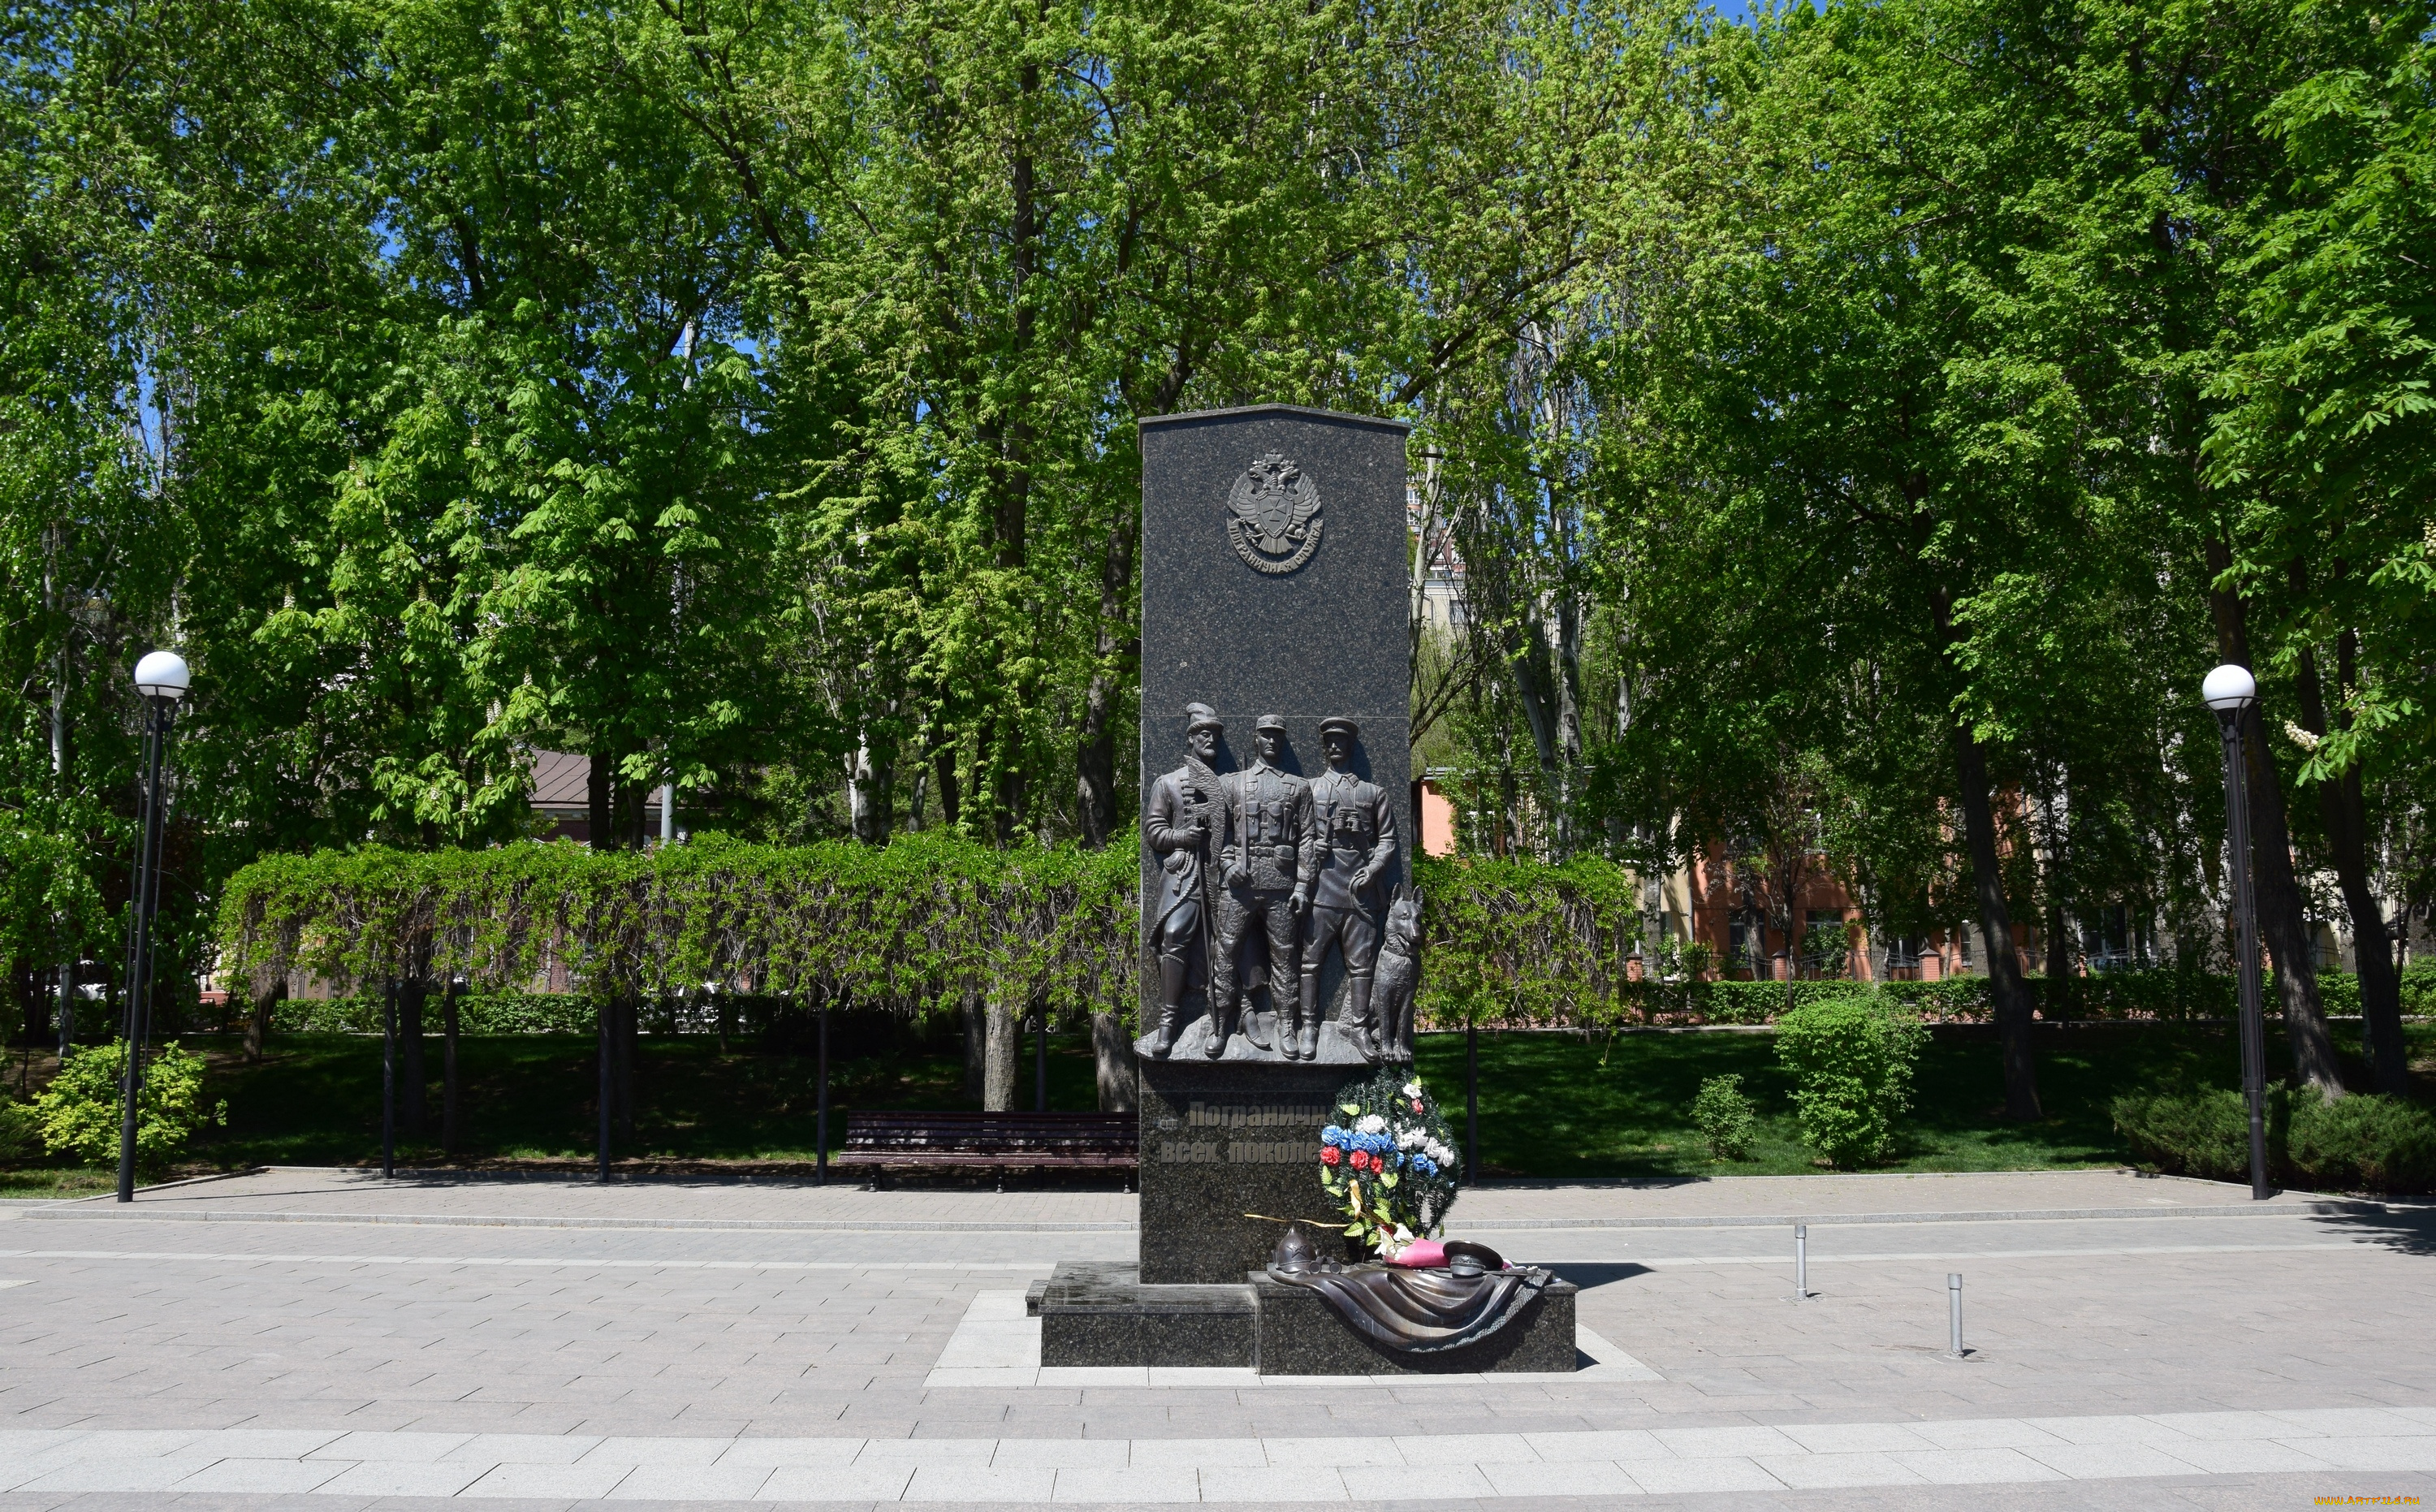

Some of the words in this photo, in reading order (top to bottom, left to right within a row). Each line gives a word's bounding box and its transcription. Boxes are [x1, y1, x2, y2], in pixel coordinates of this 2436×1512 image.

[1189, 1101, 1329, 1129] Пограничн
[1160, 1142, 1219, 1164] всех
[1228, 1142, 1320, 1164] поколе
